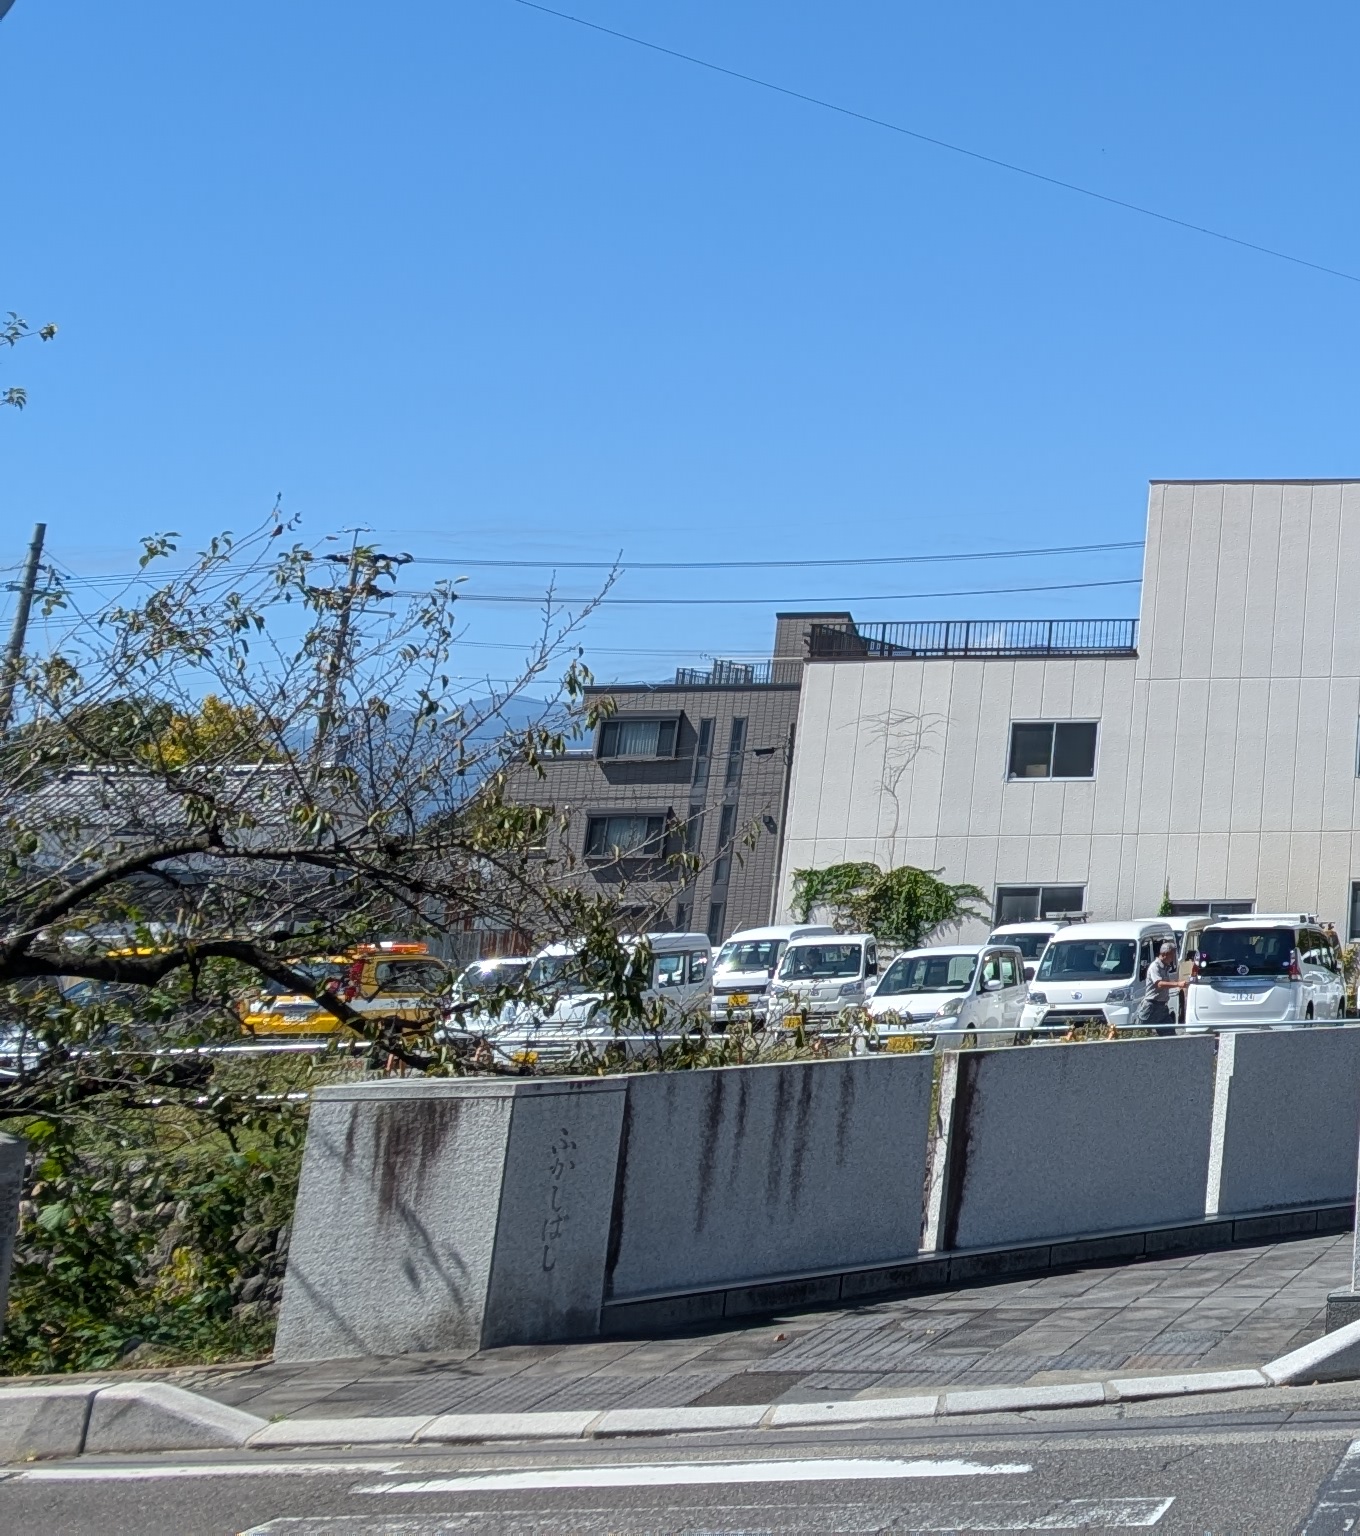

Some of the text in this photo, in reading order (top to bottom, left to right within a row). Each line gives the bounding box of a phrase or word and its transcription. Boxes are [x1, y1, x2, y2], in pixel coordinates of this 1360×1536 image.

[542, 1127, 577, 1272] ふかしばし
